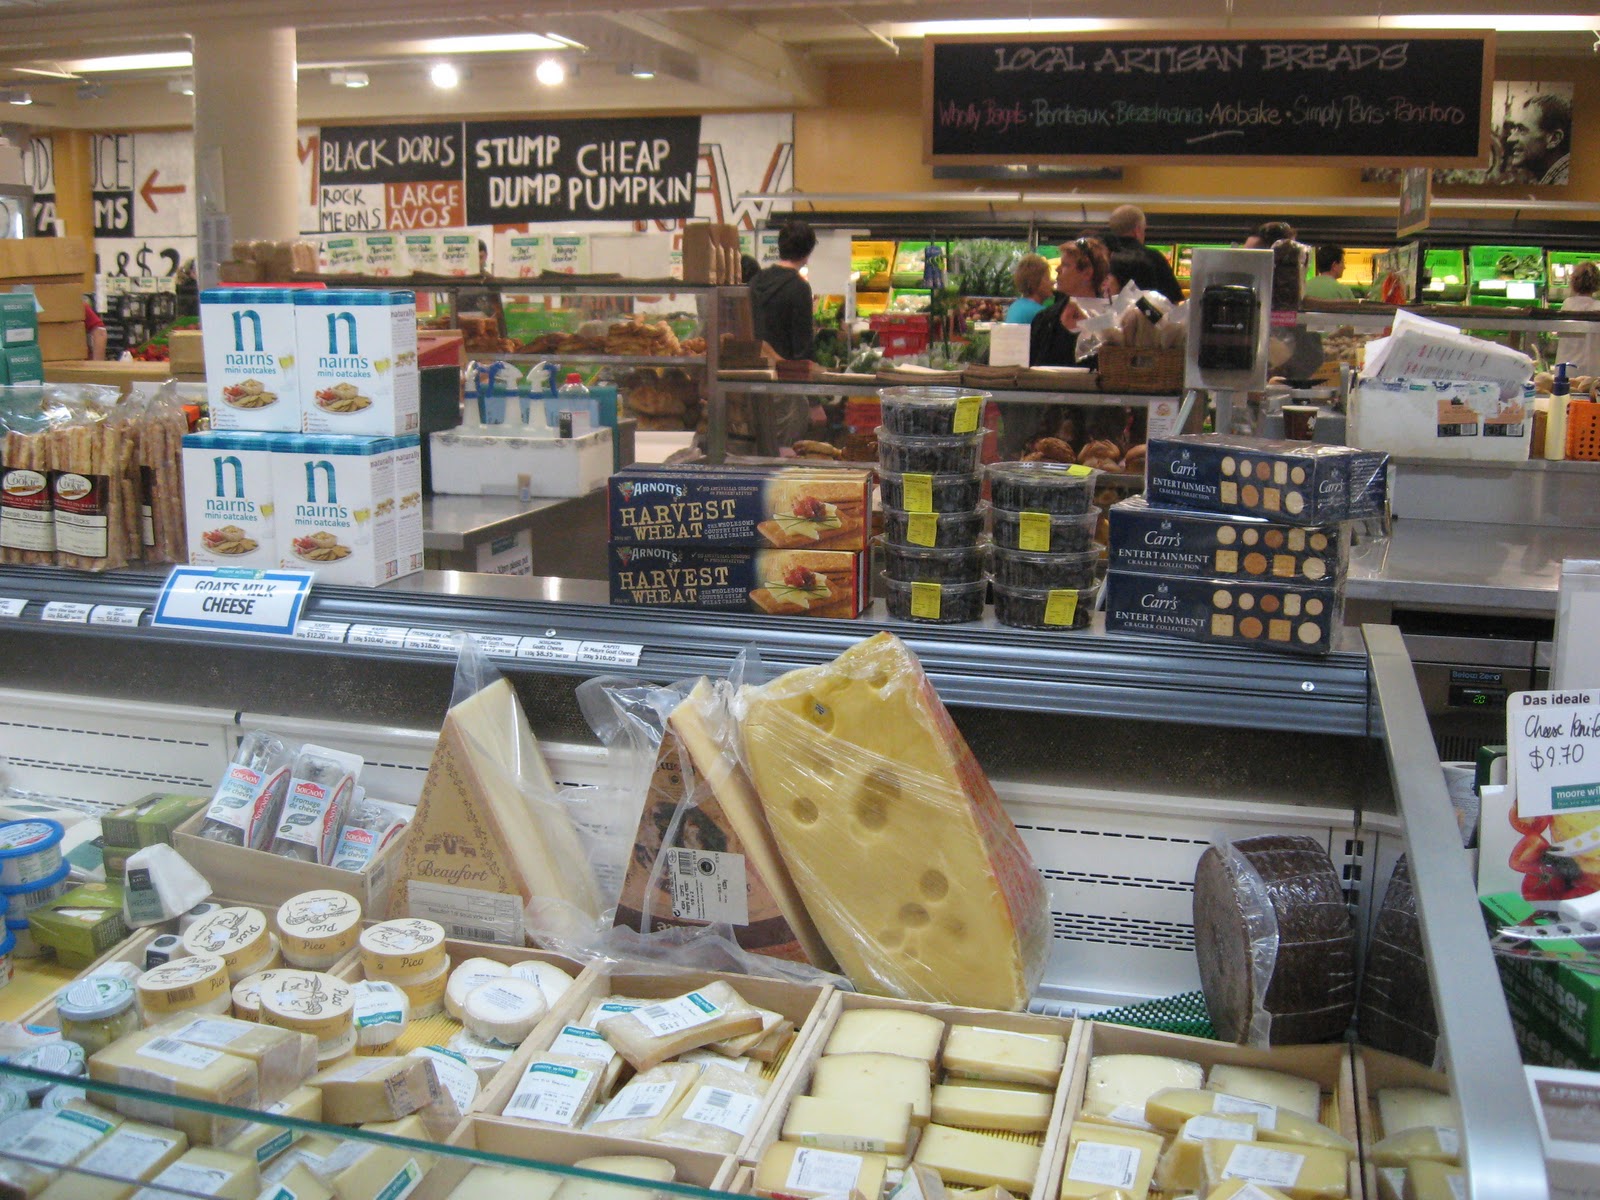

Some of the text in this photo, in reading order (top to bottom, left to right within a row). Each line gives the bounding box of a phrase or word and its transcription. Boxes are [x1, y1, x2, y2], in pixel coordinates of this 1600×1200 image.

[994, 42, 1409, 74] LOCAL ARTISAN BREADS
[1208, 101, 1283, 126] Arobake
[1291, 96, 1343, 129] Simply
[322, 135, 455, 172] BLACK DORIS
[475, 134, 671, 178] STUMP CHEAP
[322, 187, 366, 205] ROCK
[390, 183, 459, 208] LARGE
[488, 171, 693, 211] DUMP PUMPKIN
[321, 208, 382, 232] MELONS
[390, 205, 452, 229] AVOS
[224, 366, 277, 376] mini oatcakes
[317, 369, 372, 379] mini oatcakes
[1169, 459, 1198, 477] Carr's
[633, 481, 683, 498] ARNOTT'S
[1152, 476, 1218, 495] ENTERTAINMENT
[204, 512, 258, 522] mini oatcakes
[619, 498, 737, 527] HARVEST
[294, 517, 351, 528] mini oatcakes
[632, 522, 703, 541] WHEAT
[1143, 530, 1182, 548] Carr's
[1118, 548, 1210, 565] ENTERTAINMENT
[1127, 558, 1200, 571] CRACKER COLLECTION
[618, 566, 730, 592] HARVEST
[194, 580, 277, 598] GOAT'S MILK
[631, 588, 698, 605] WHEAT
[202, 596, 256, 615] CHEESE
[1140, 592, 1179, 611] Carr's
[1115, 610, 1206, 628] ENTERTAINMENT
[1124, 621, 1196, 634] CRACKER COLLECTION
[1522, 692, 1590, 706] Das ideale
[1524, 714, 1564, 739] Cheese
[1528, 743, 1585, 772] $9.70
[230, 769, 260, 785] SOIGNON
[295, 784, 325, 799] SOIGNON
[1556, 789, 1586, 799] moore
[254, 789, 273, 821] SOIGNON
[293, 795, 321, 809] Fromage
[323, 801, 338, 835] SOIGNON
[416, 859, 488, 885] Beaufort
[235, 924, 261, 944] Pico
[305, 922, 338, 934] Pico
[409, 920, 437, 932] Pico
[303, 940, 326, 950] Pico
[400, 957, 425, 969] Pico
[331, 988, 350, 1008] Pico
